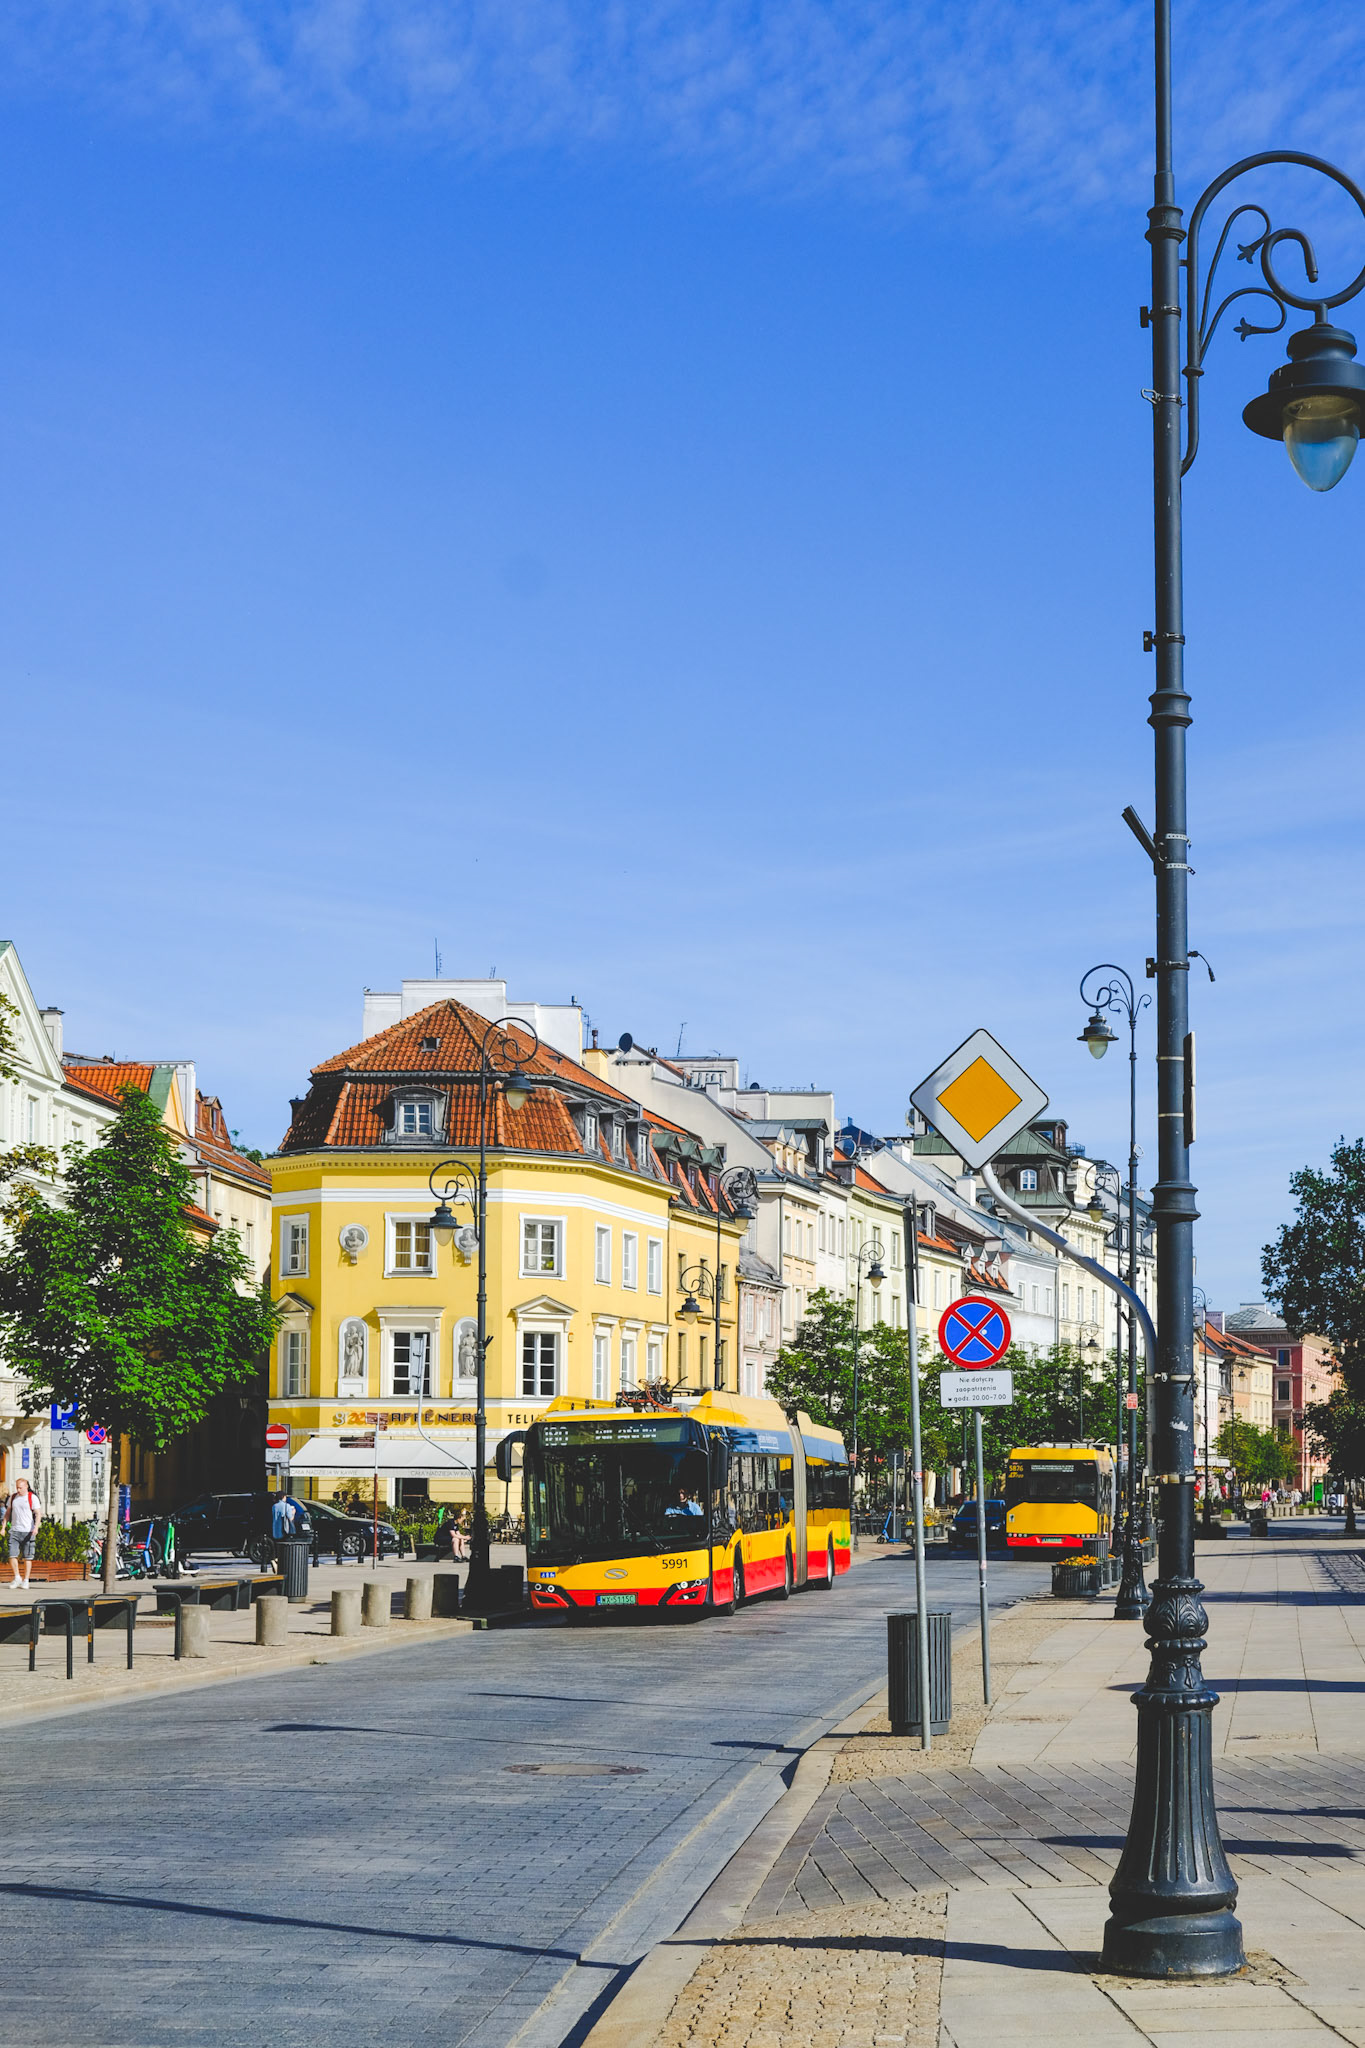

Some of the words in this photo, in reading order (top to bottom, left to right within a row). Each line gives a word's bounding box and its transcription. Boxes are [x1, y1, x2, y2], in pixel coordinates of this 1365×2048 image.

[956, 1385, 997, 1393] zaopatrzenia
[438, 1413, 479, 1422] NER
[661, 1558, 688, 1570] 5991
